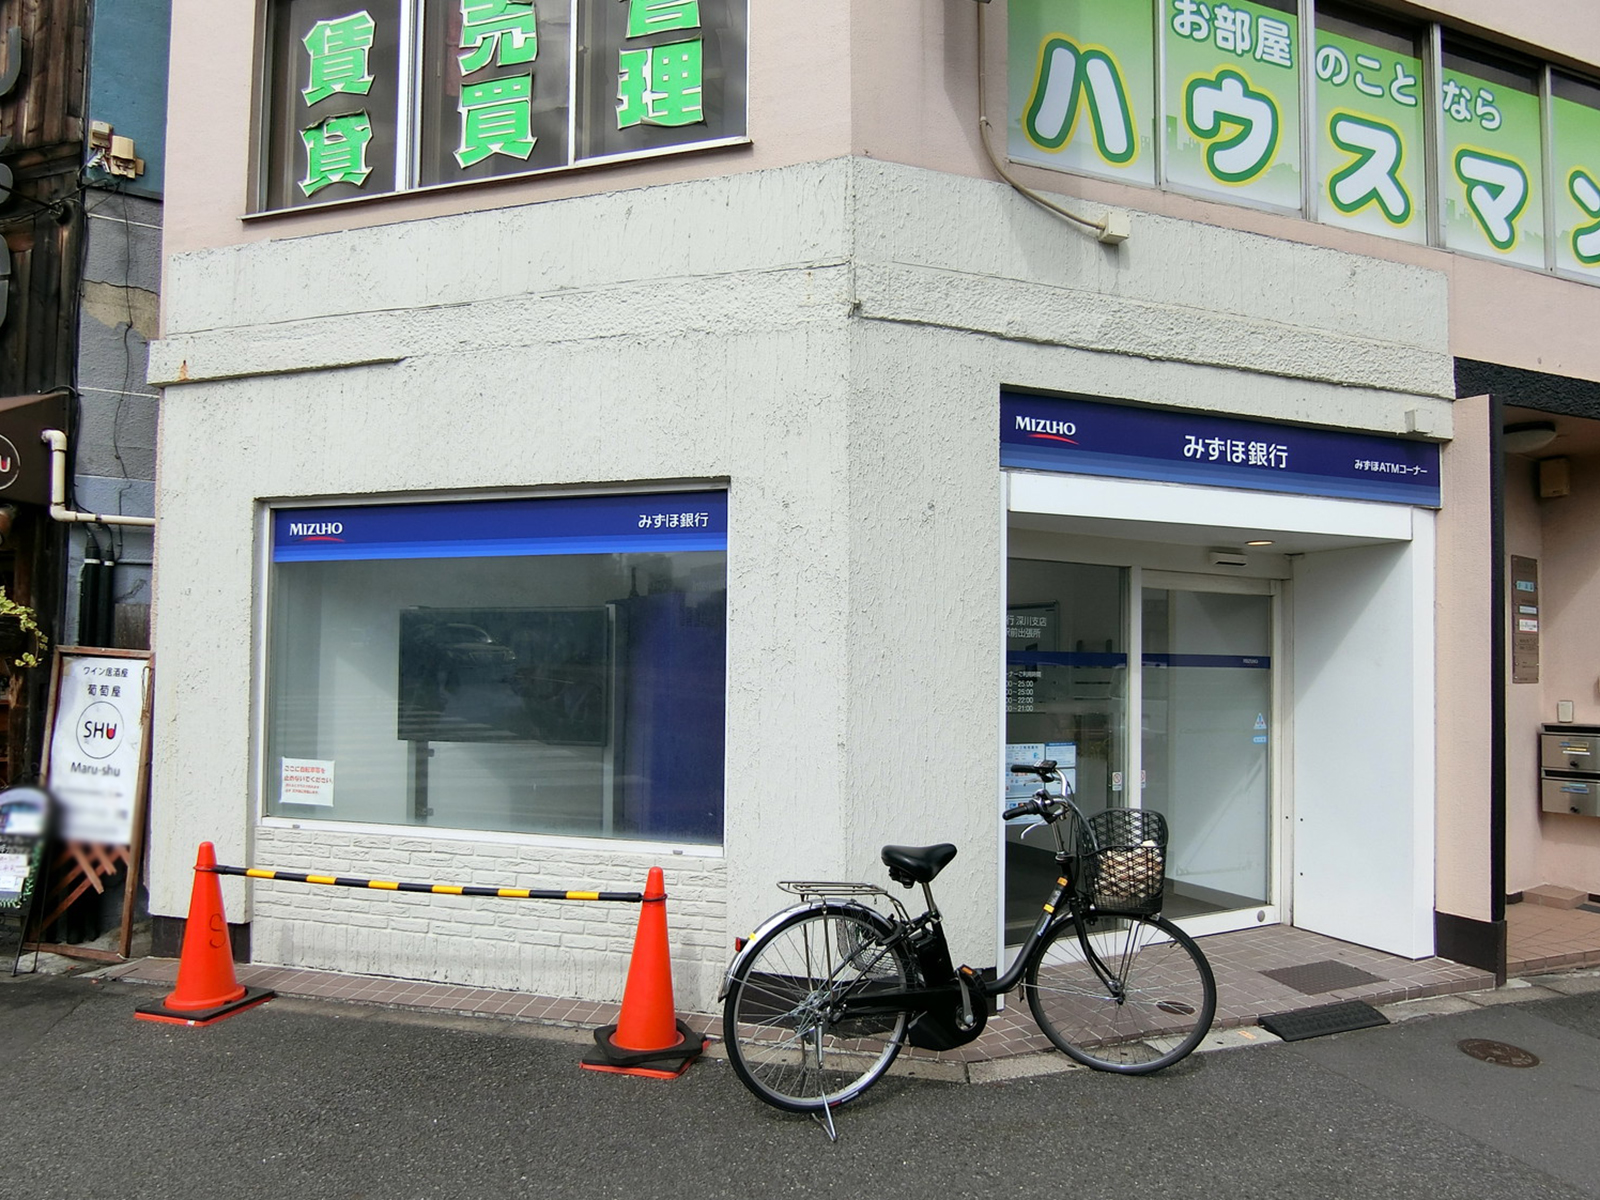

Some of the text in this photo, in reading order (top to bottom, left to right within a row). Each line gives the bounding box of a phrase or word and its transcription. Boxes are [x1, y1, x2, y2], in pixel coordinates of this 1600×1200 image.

[453, 0, 538, 169] 売買
[299, 8, 378, 198] 賃貸
[1015, 415, 1077, 437] MIZUHO
[1183, 434, 1289, 470] みずほ銀行
[1354, 459, 1428, 476] みずほATMコーナー
[289, 522, 343, 536] MIZUHO
[637, 512, 709, 529] みずほ銀行
[83, 666, 129, 678] ワイン居酒屋
[83, 720, 117, 740] SHU
